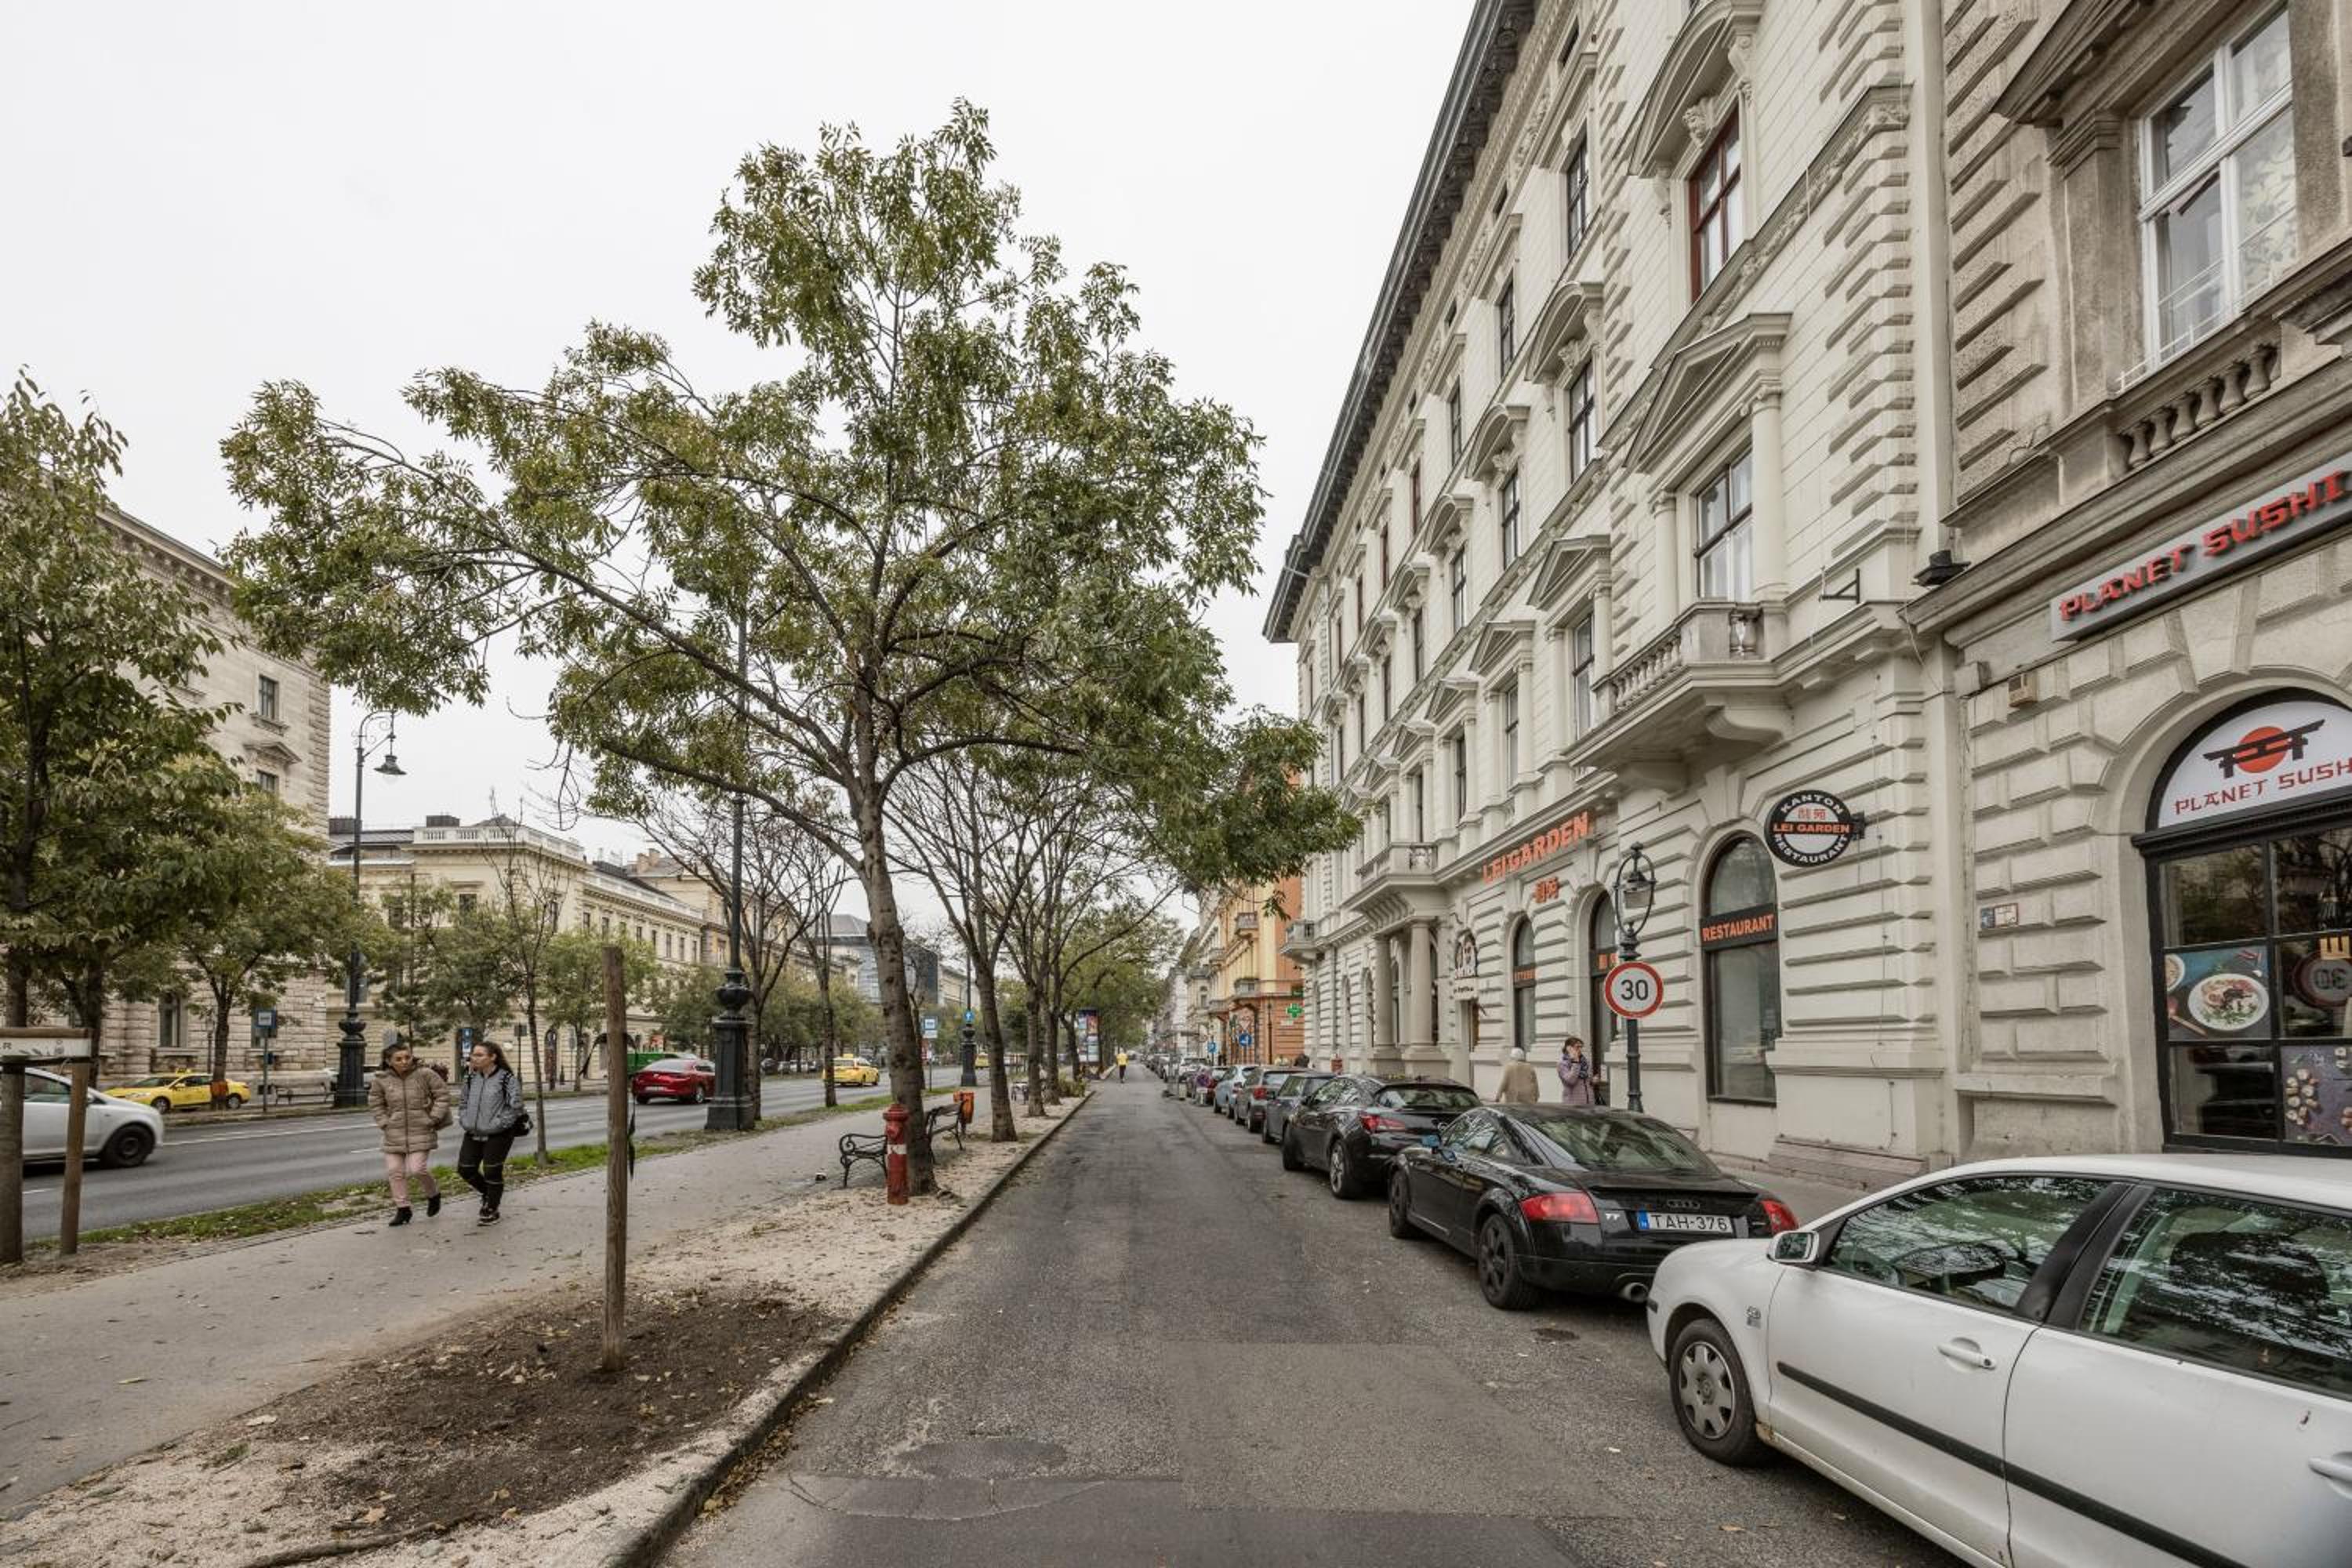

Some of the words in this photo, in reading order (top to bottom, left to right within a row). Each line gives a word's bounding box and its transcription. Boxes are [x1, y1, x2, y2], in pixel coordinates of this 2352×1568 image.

[2060, 545, 2193, 620] PLANET
[2202, 470, 2348, 555] SUSHI
[1781, 795, 1842, 813] KANTON
[2175, 779, 2268, 814] PLANET
[1773, 823, 1794, 832] LEI
[1797, 824, 1849, 833] GARDEN
[1483, 855, 1506, 884] LEI
[1508, 811, 1588, 873] GARDEN
[1775, 833, 1848, 863] RESTAURANT
[1702, 913, 1774, 941] RESTAURANT
[1621, 979, 1649, 1001] 30
[1650, 1214, 1727, 1230] TAH-376
